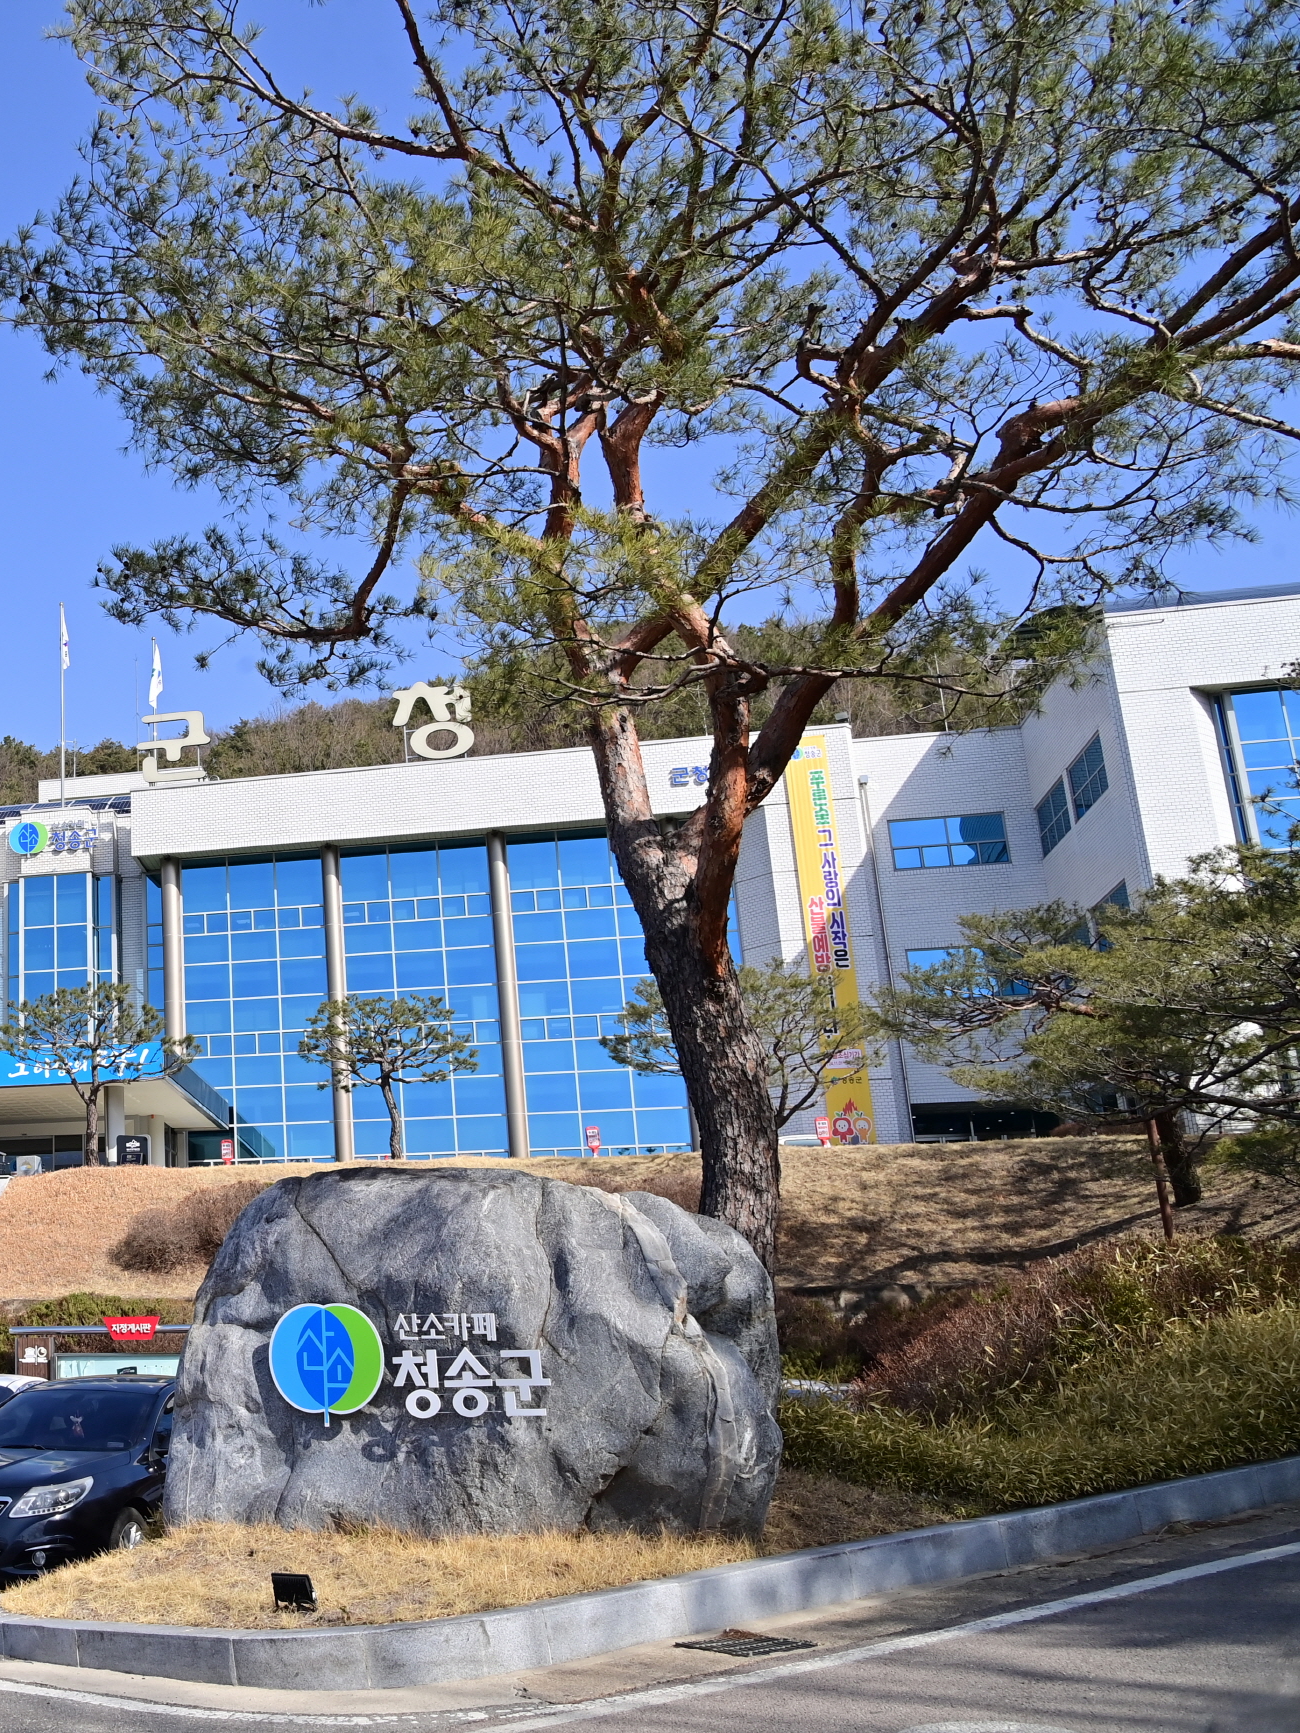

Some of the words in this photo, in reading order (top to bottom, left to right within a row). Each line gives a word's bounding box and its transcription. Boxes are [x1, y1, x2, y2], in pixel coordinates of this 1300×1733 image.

[51, 829, 99, 851] 청송군
[817, 829, 834, 847] 그
[821, 851, 842, 908] 사랑의
[830, 911, 850, 968] 시작은
[7, 1062, 30, 1079] 그
[111, 1323, 152, 1334] 지정게시판
[393, 1313, 497, 1341] 산소카페
[392, 1346, 551, 1419] 청송군
